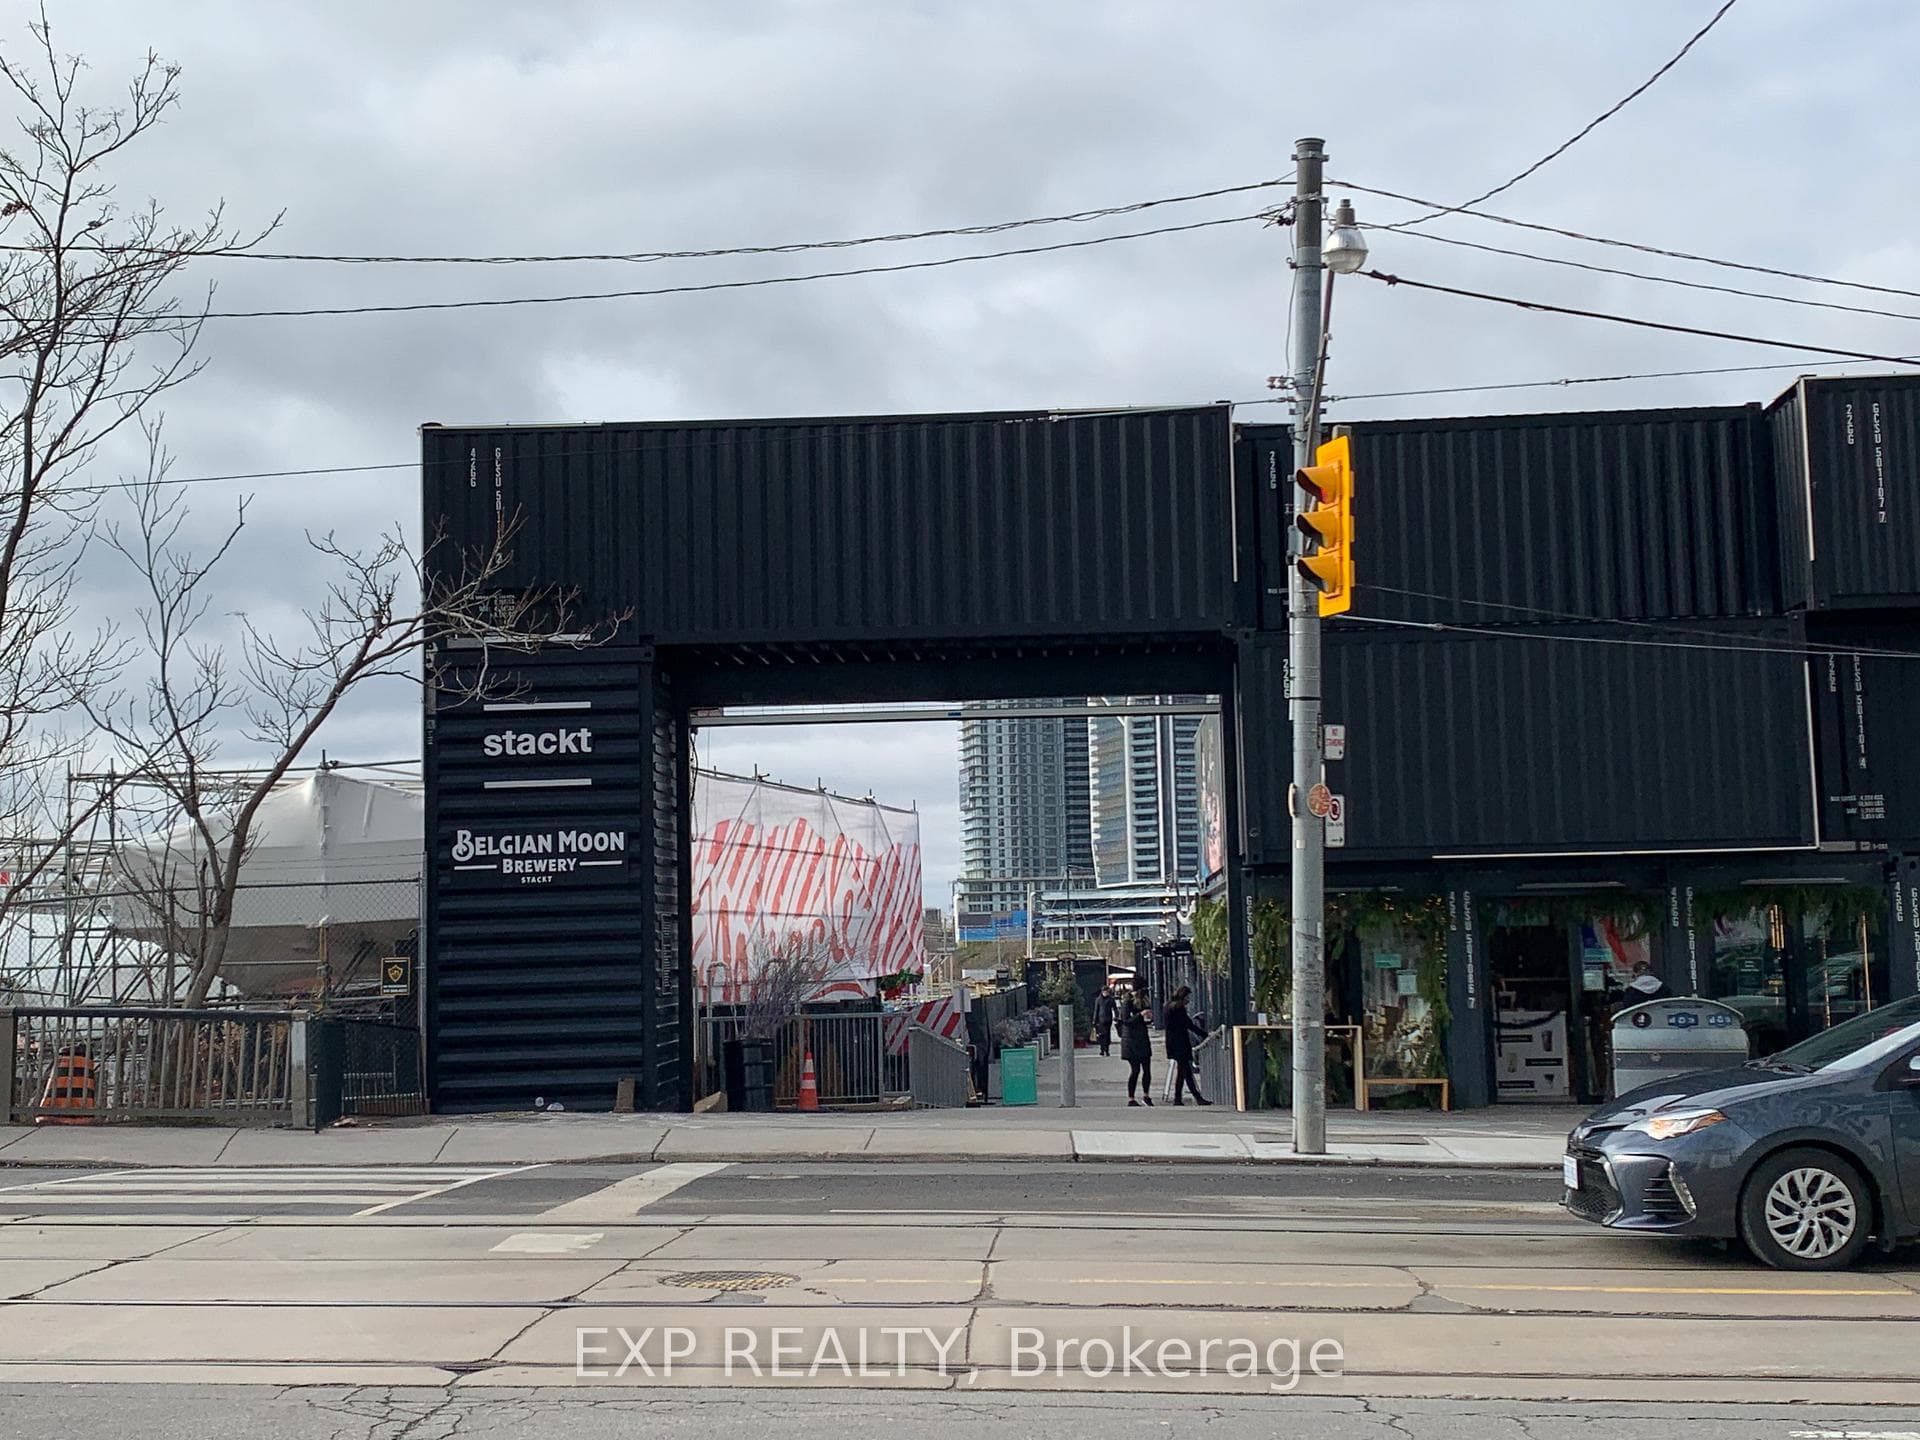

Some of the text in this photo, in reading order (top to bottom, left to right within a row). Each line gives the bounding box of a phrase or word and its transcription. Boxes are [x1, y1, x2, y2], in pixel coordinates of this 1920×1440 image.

[1872, 403, 1881, 444] GCSU
[1875, 447, 1884, 508] 501107
[483, 727, 593, 758] stackt
[452, 829, 625, 862] BELGIAN MOON
[502, 858, 577, 874] BREWERY
[520, 875, 553, 884] STACKT
[1911, 888, 1920, 929] GCSU
